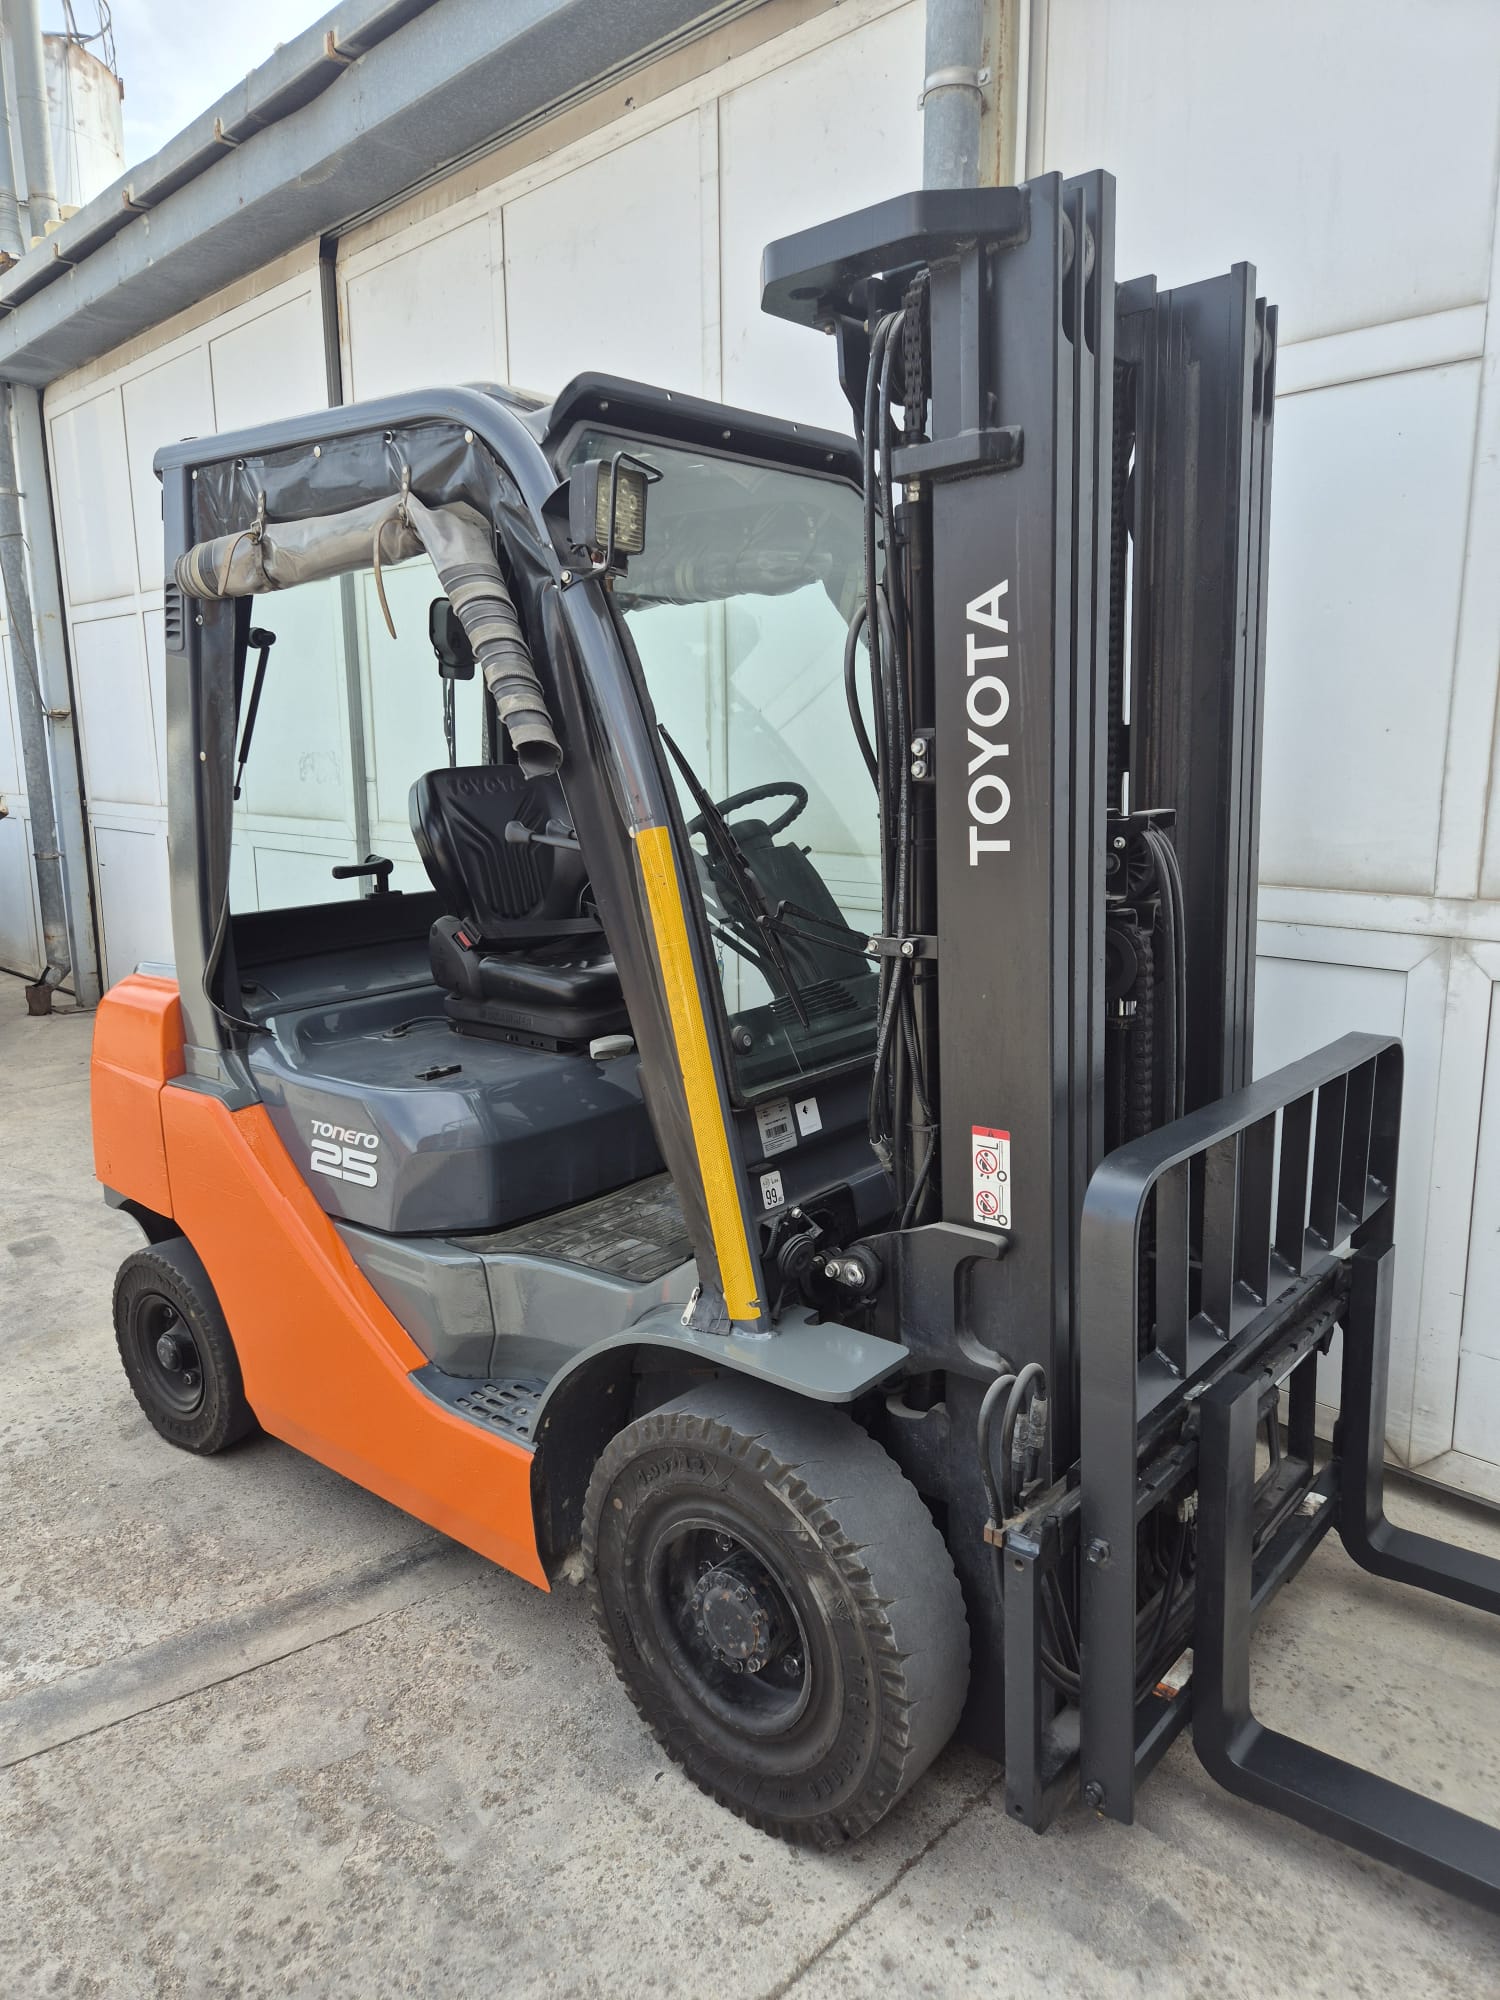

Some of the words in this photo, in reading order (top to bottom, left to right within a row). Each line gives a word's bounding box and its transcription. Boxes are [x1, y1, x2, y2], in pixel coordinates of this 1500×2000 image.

[966, 578, 1011, 866] TOYOTA
[310, 1139, 378, 1188] 25
[765, 1187, 778, 1206] 99
